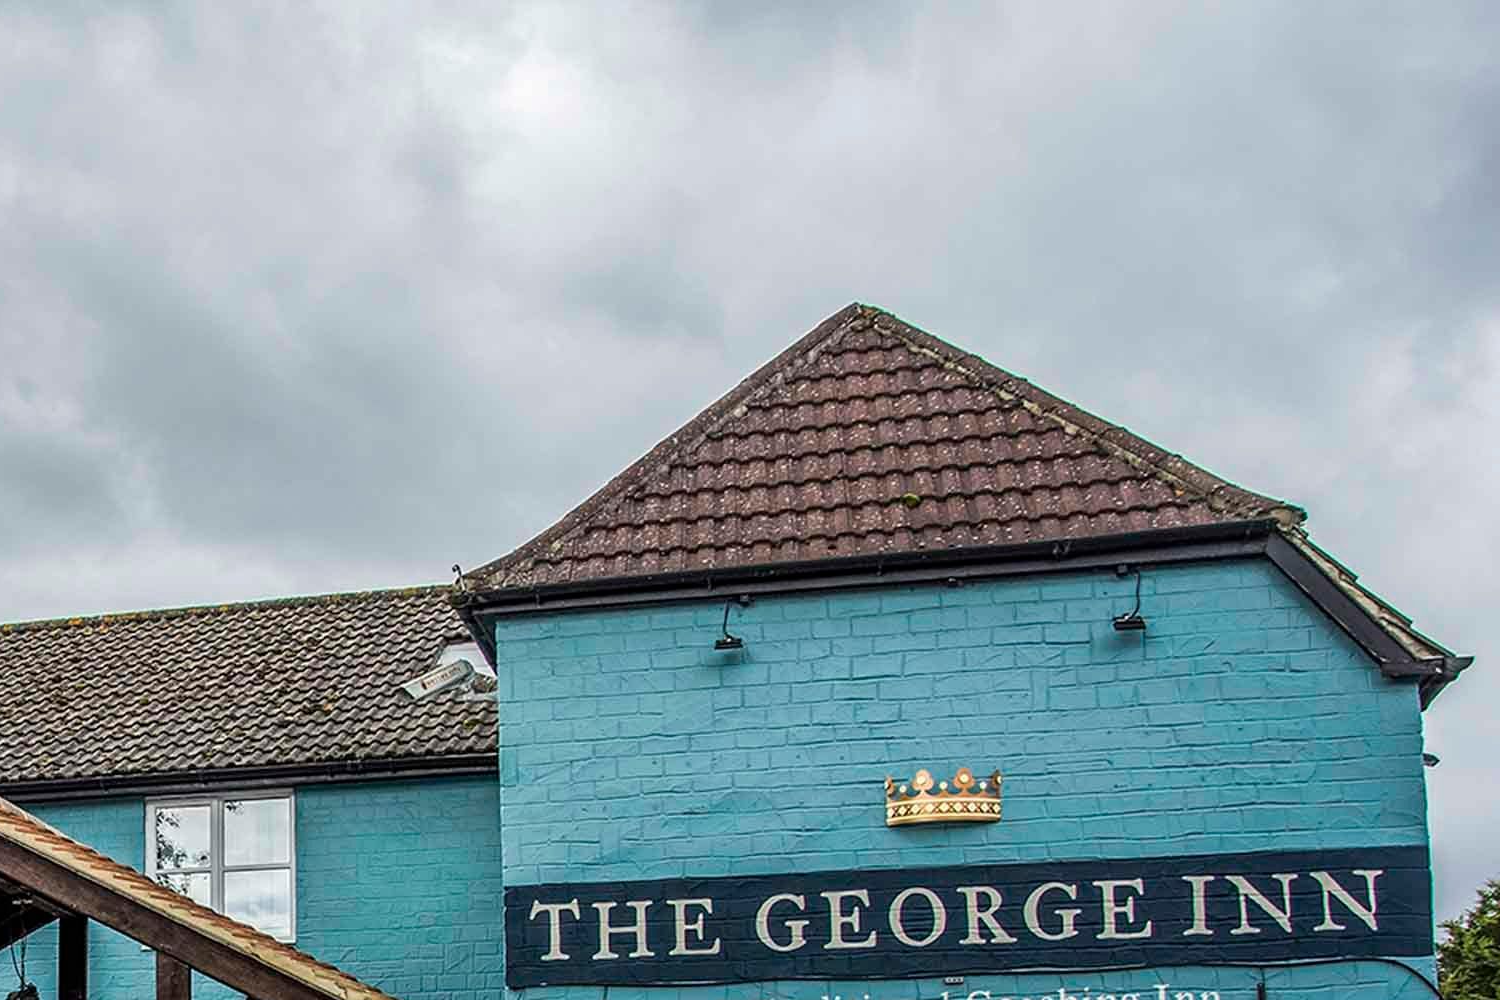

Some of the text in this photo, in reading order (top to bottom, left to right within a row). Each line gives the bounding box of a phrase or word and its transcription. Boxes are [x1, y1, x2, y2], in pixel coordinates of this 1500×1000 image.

[529, 869, 1384, 961] THE GEORGE INN
